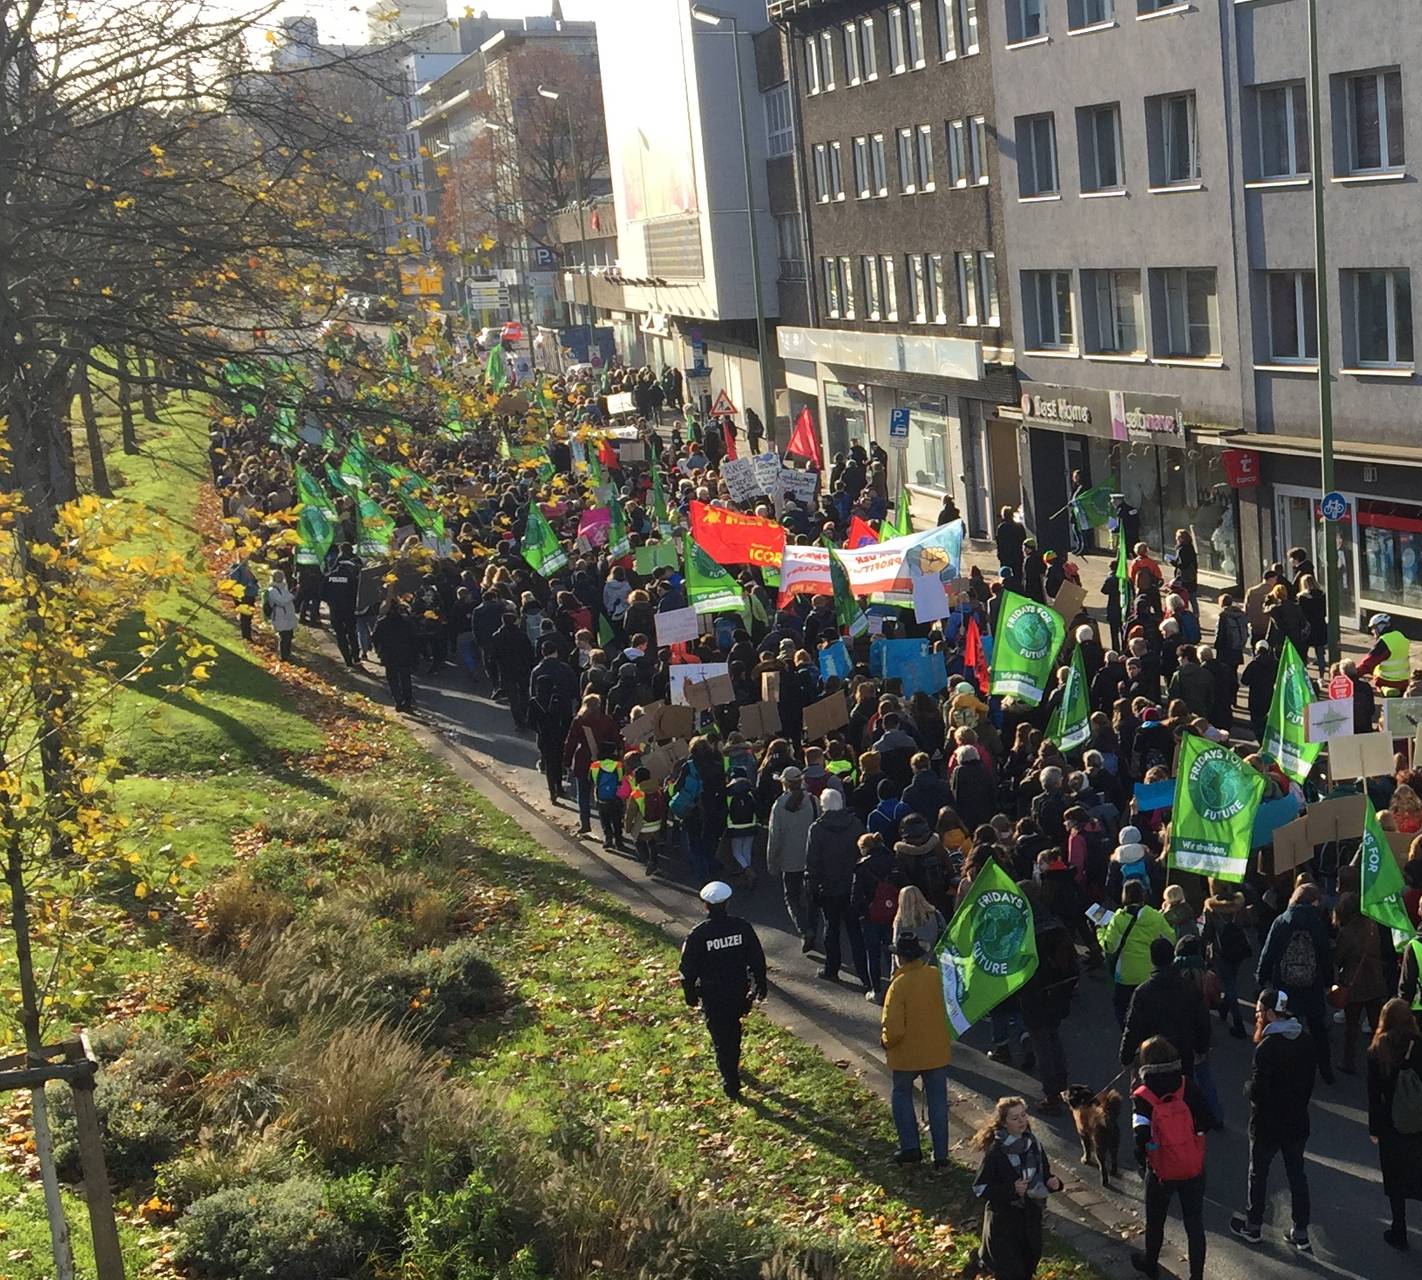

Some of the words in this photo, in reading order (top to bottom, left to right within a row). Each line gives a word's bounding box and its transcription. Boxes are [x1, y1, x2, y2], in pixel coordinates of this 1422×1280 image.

[538, 250, 551, 265] P
[893, 410, 903, 422] P
[749, 548, 782, 564] ICOR
[1006, 605, 1036, 629] FRIDAYS
[1036, 606, 1053, 625] FOR
[1189, 749, 1224, 782] FRIDAYS
[1203, 799, 1245, 820] FUTURE
[1368, 848, 1380, 874] FOR
[980, 892, 1023, 908] FRIDAYS
[706, 934, 743, 952] POLIZEI
[972, 941, 1008, 974] FUTURE
